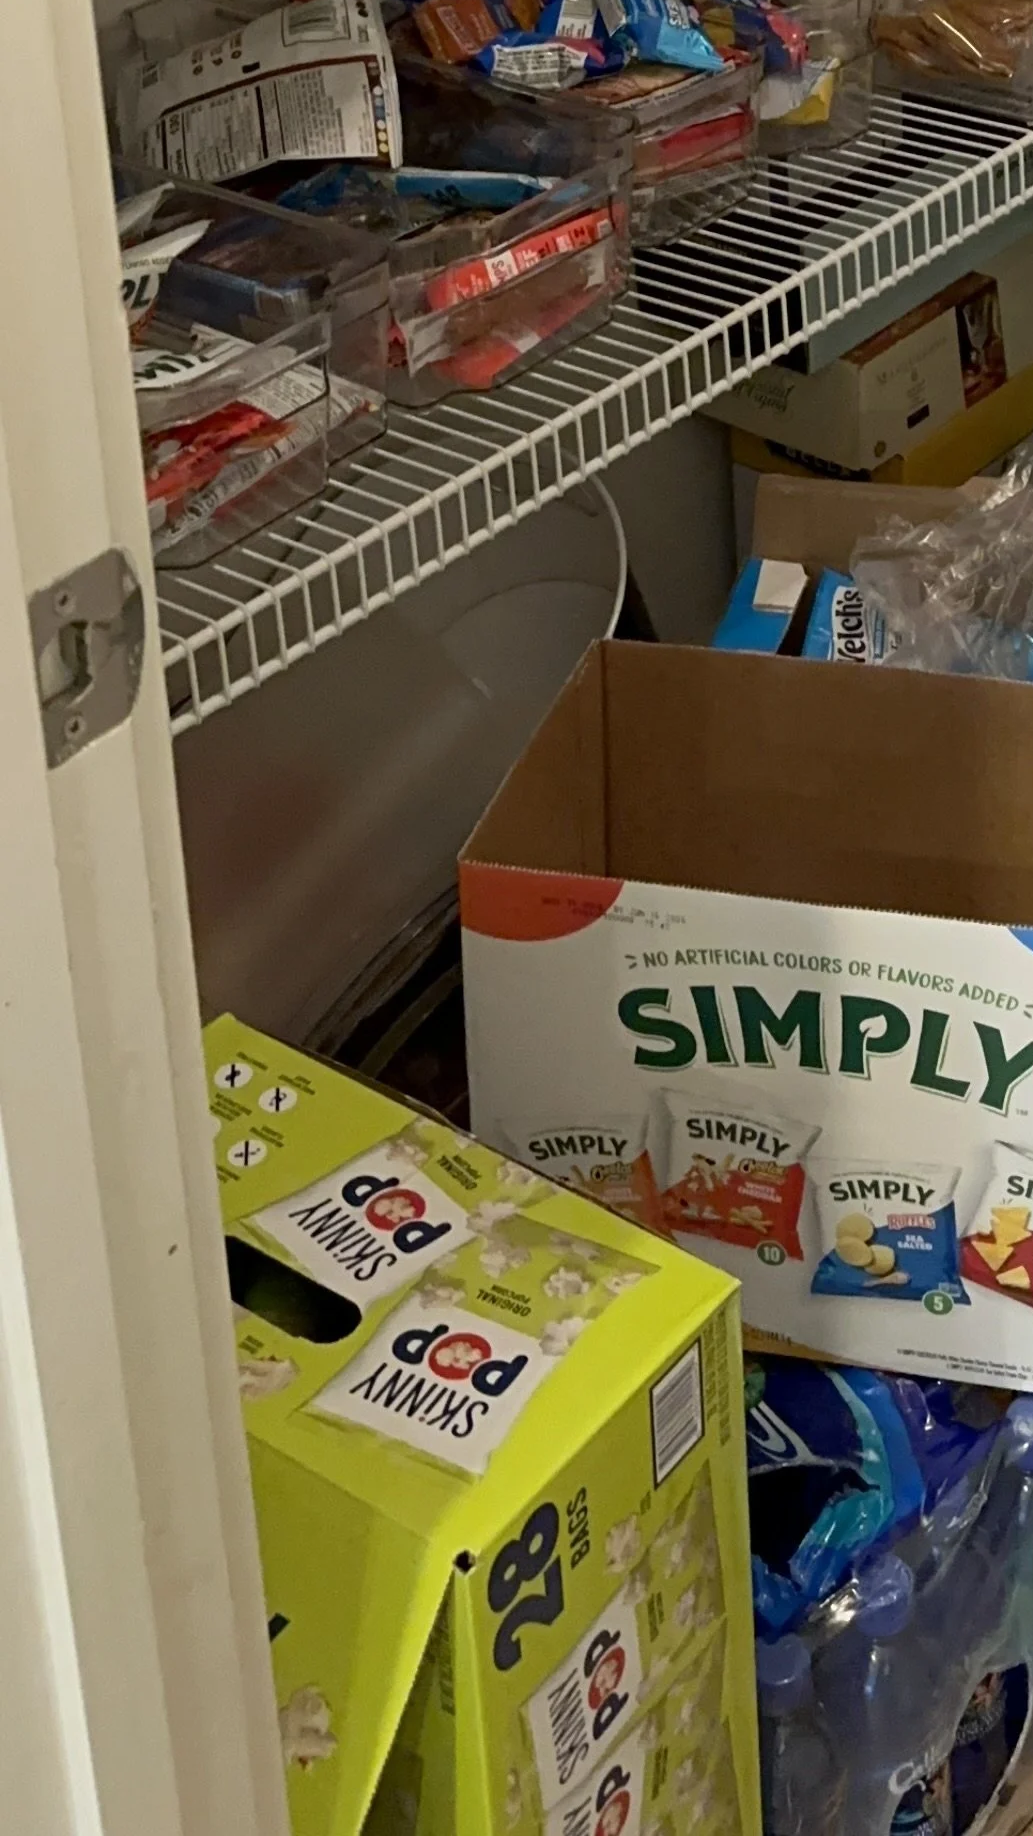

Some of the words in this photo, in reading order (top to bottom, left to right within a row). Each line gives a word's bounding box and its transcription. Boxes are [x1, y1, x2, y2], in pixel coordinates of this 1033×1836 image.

[643, 951, 669, 968] NO
[674, 948, 769, 967] ARTIFICIAL
[773, 951, 842, 975] COLORS
[848, 960, 872, 978] OR
[877, 963, 954, 994] FLAVORS
[958, 982, 1019, 1012] ADDED
[528, 1134, 628, 1162] SIMPLY
[686, 1117, 791, 1159] SIMPLY
[341, 1174, 452, 1254] POP
[828, 1178, 935, 1206] SIMPLY
[289, 1198, 397, 1282] SKINNY
[887, 1213, 936, 1230] RUFFLES
[897, 1241, 933, 1252] SALTED
[904, 1234, 925, 1244] SEA
[762, 1246, 780, 1262] 10
[475, 1289, 532, 1318] ORIGINAL
[933, 1294, 944, 1311] 5
[391, 1323, 529, 1397] POP
[349, 1362, 490, 1438] SKINNY
[566, 1486, 591, 1570] BAGS
[488, 1502, 565, 1672] 28
[583, 1628, 629, 1741] POP
[546, 1667, 590, 1786] SKINNY
